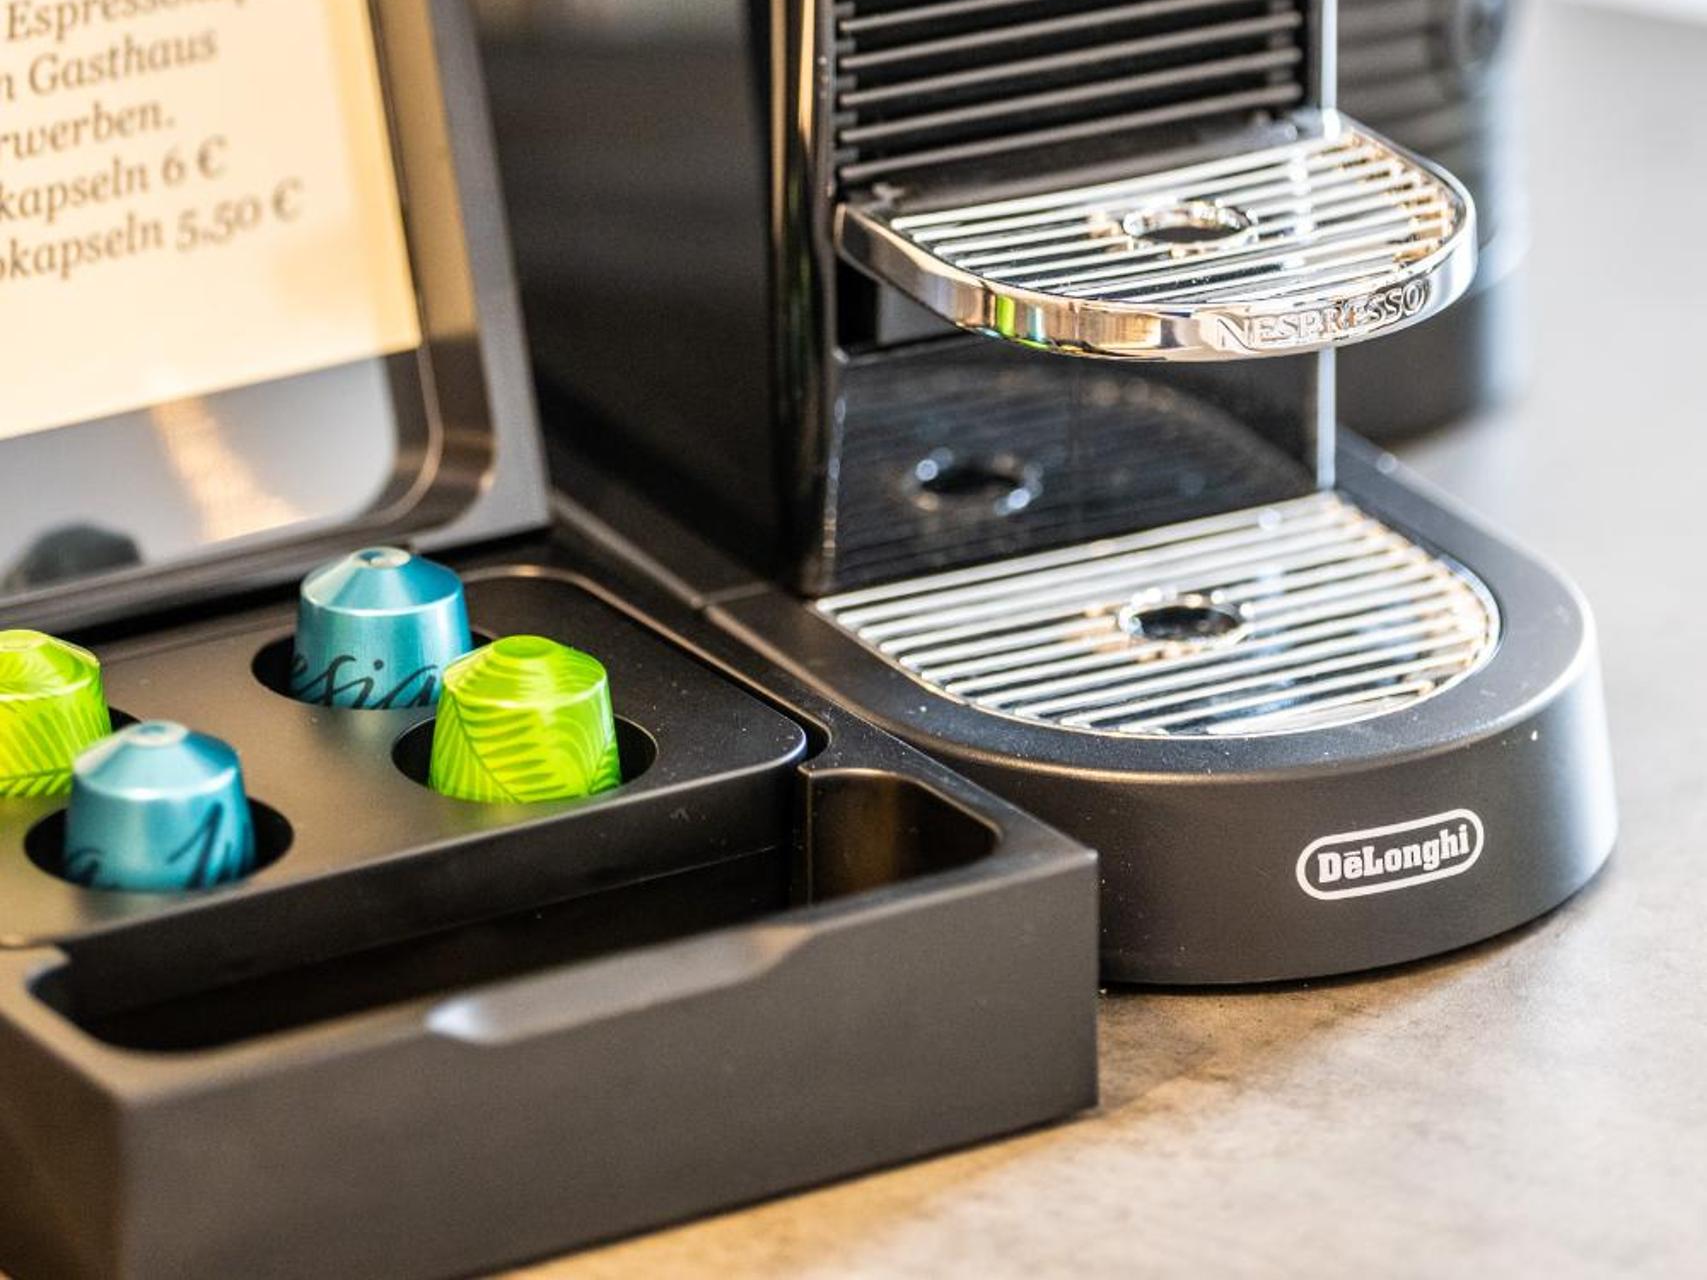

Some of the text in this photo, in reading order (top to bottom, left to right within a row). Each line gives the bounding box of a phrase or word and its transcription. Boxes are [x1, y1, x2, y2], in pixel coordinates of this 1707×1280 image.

[28, 28, 218, 96] Gasthaus
[161, 145, 186, 186] 6
[1211, 277, 1430, 354] NESPRESSO
